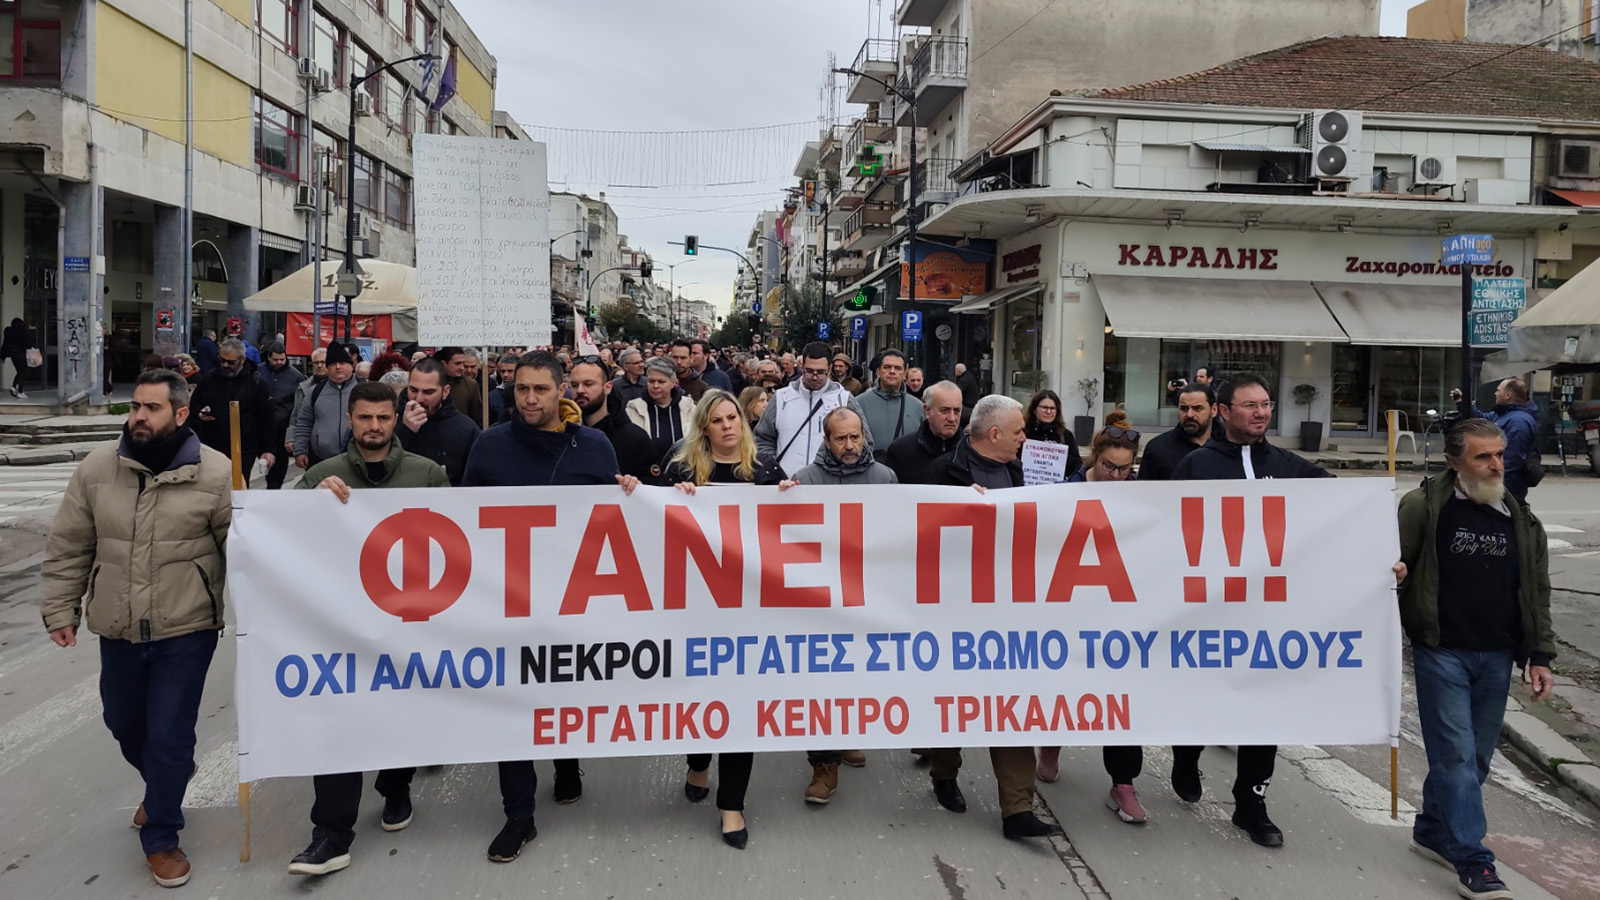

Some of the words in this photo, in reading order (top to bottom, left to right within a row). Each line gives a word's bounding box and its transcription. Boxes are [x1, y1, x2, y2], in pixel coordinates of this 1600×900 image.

[1118, 245, 1278, 270] ΚΑΡΑΛΗΣ
[1346, 257, 1514, 277] Ζαχαροπλατείο
[1476, 280, 1518, 288] ΠΛΑΤΕΙΑ
[1472, 300, 1525, 309] ΑΝΤΙΣΤΑΣΗΣ
[820, 323, 828, 333] P
[854, 318, 864, 330] P
[906, 313, 919, 329] P
[1480, 334, 1509, 343] SQUARE
[360, 503, 864, 623] ΦΤΑΝΕΙ
[916, 500, 1137, 604] ΠΙΑ
[275, 653, 356, 698] ΟΧΙ
[370, 648, 505, 691] ΑΛΛΟΙ
[520, 639, 672, 685] ΝΕΚΡΟΙ
[686, 634, 854, 677] ΕΡΓΑΤΕΣ
[866, 632, 940, 672] ΣΤΟ
[952, 630, 1068, 670] ΒΩΜΟ
[1079, 630, 1158, 669] ΤΟΥ
[1170, 630, 1362, 670] ΚΕΡΔΟΥΣ
[533, 701, 730, 745] ΕΡΓΑΤΙΚΟ
[757, 696, 909, 737] ΚΕΝΤΡΟ
[934, 693, 1130, 733] ΤΡΙΚΑΛΩΝ
